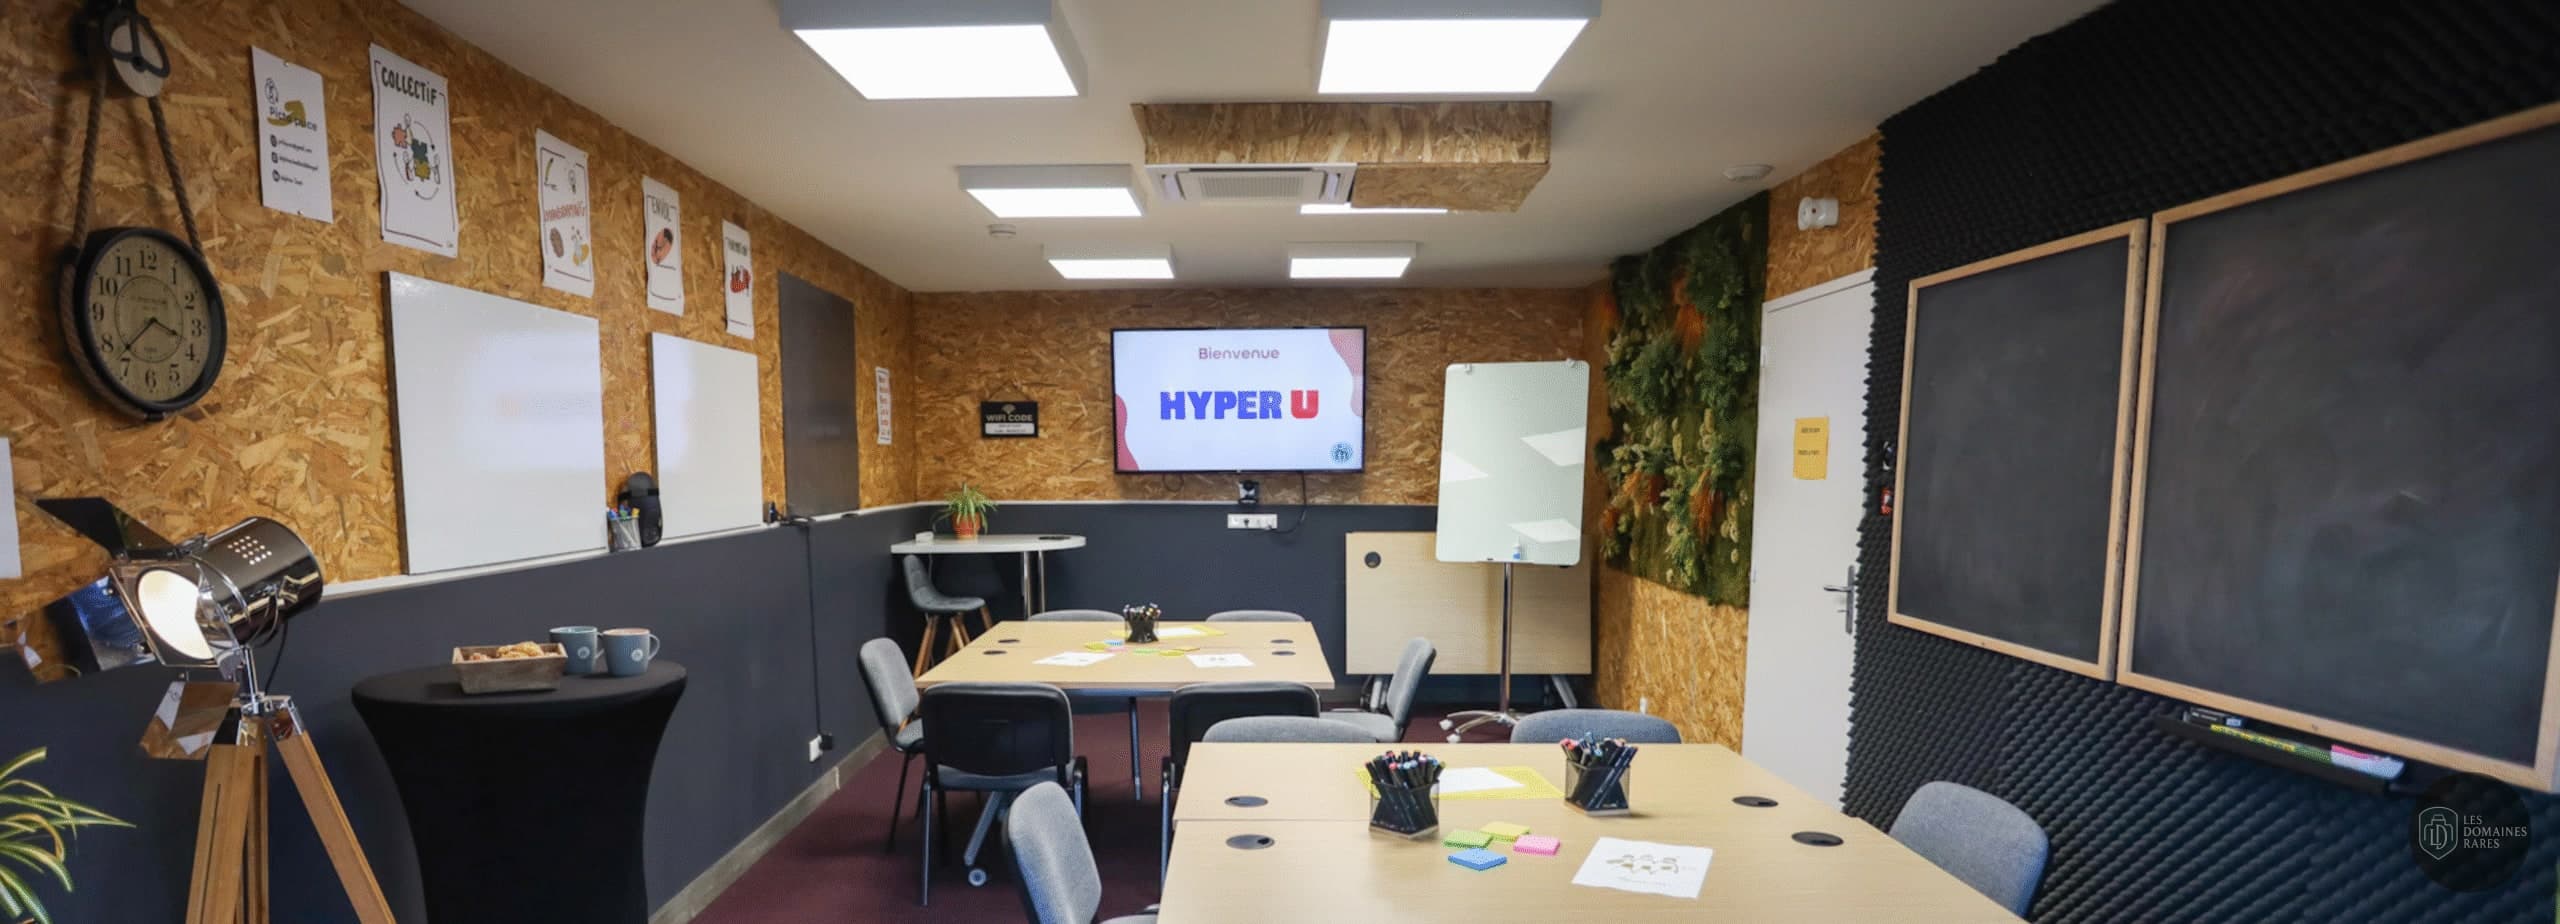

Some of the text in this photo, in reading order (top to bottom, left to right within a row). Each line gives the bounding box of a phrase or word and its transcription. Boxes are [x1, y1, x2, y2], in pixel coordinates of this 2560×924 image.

[116, 256, 132, 277] 11
[139, 250, 157, 270] 12
[170, 265, 178, 285] 1
[98, 276, 119, 296] 10
[185, 292, 195, 310] 2
[92, 303, 105, 321] 9
[191, 319, 202, 337] 3
[101, 333, 114, 353] 8
[185, 344, 195, 361] 4
[1198, 347, 1281, 360] Bienvenue
[119, 357, 131, 377] 7
[168, 363, 180, 382] 5
[144, 369, 157, 389] 6
[1160, 389, 1319, 420] HYPER U
[1008, 414, 1033, 422] CODE
